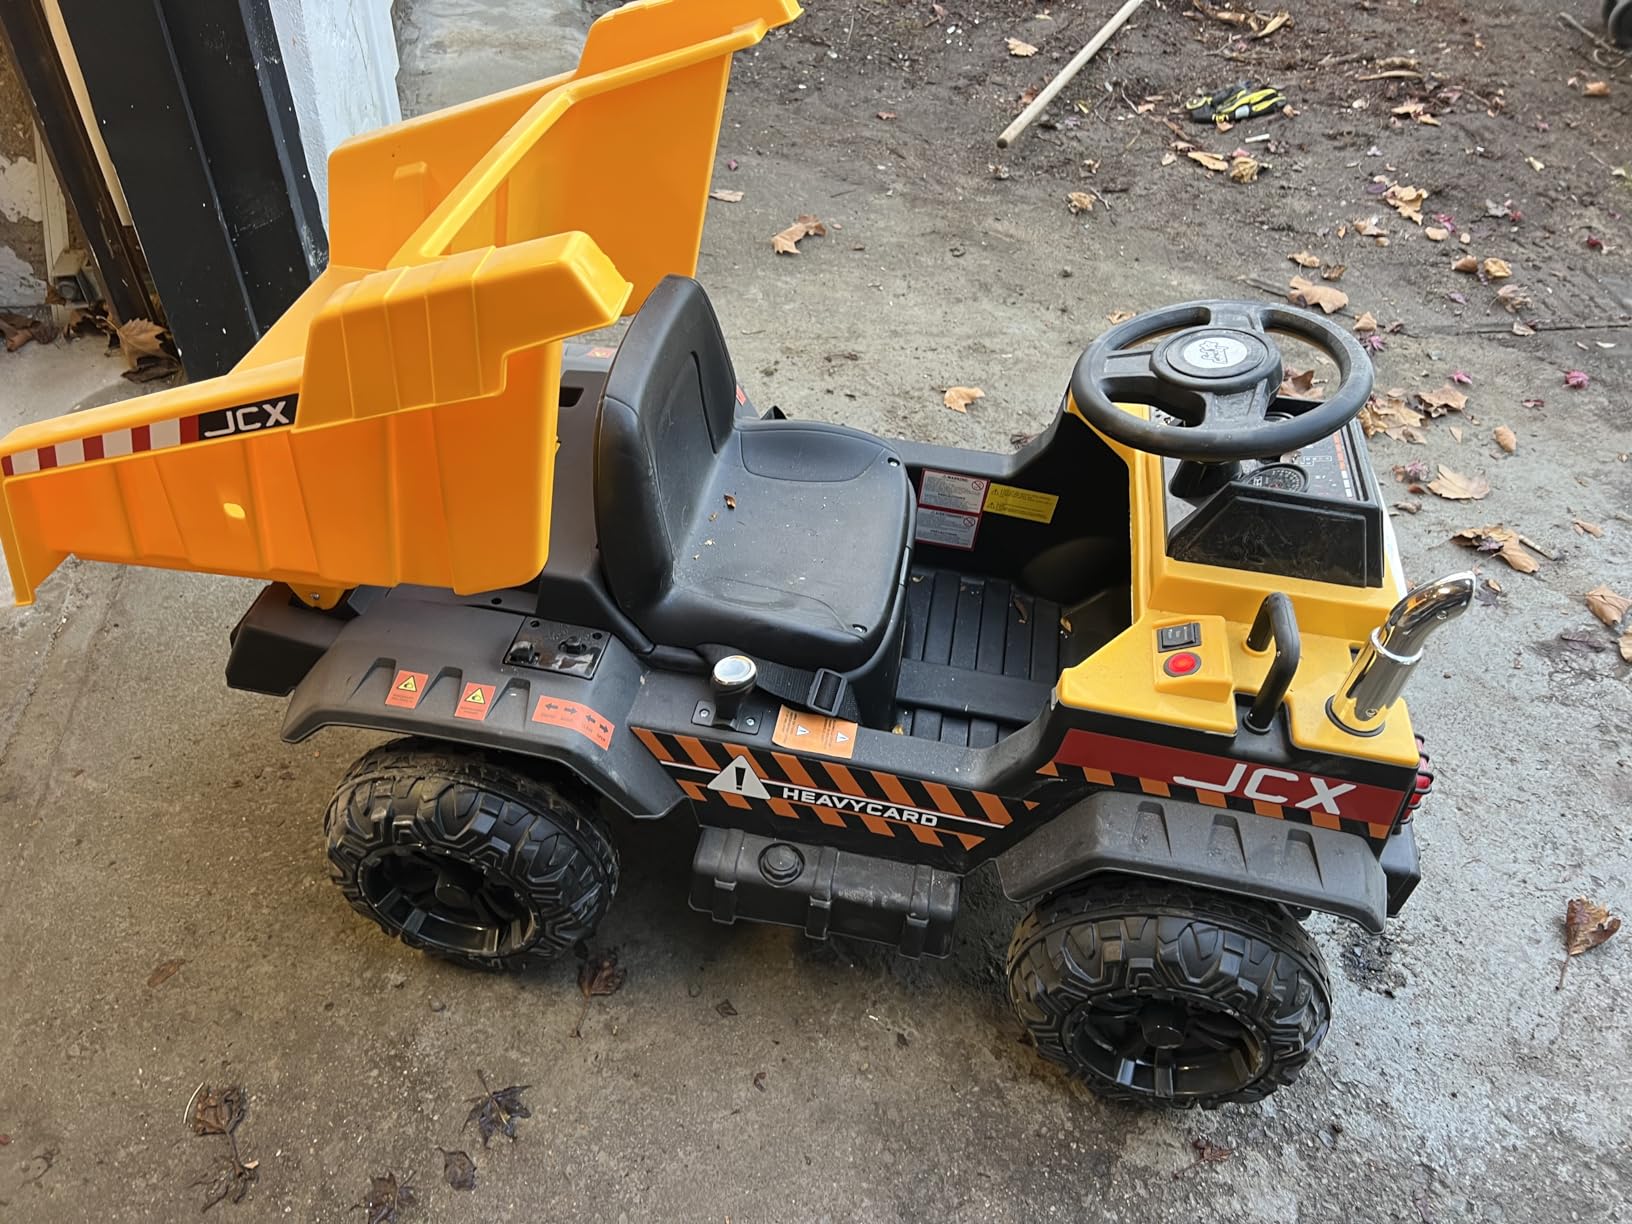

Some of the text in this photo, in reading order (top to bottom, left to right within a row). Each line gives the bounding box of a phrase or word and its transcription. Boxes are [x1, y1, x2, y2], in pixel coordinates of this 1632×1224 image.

[204, 401, 289, 438] JCX
[782, 788, 937, 826] HEAVYCARD
[1173, 763, 1356, 815] JCX
